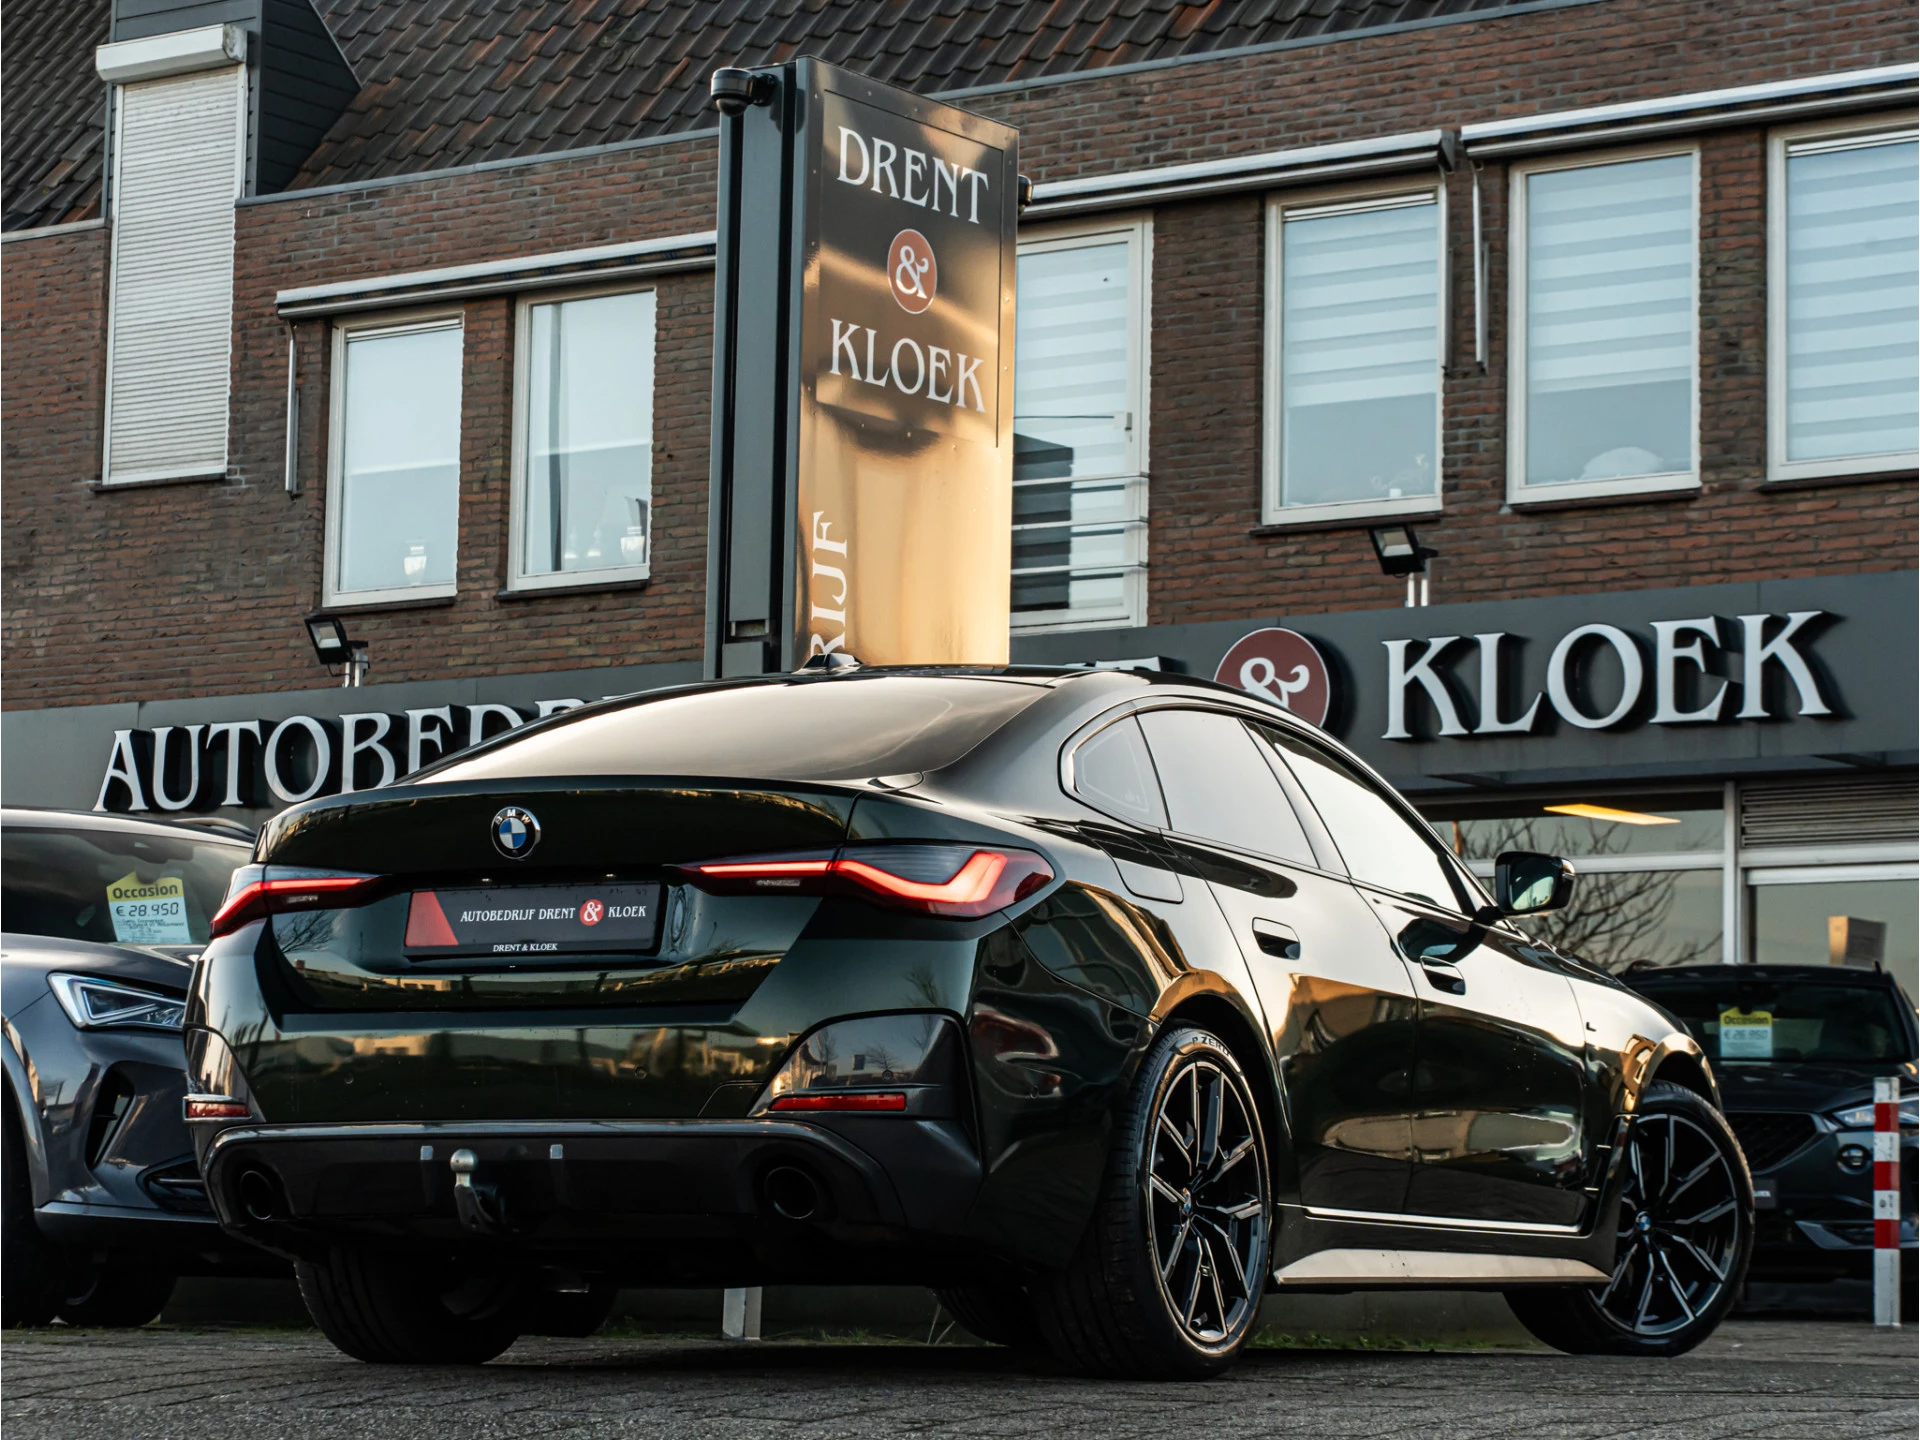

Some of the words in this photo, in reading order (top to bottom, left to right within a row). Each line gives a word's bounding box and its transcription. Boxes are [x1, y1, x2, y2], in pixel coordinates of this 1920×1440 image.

[837, 126, 989, 224] DRENT
[895, 245, 930, 300] &
[829, 318, 986, 414] KLOEK
[1381, 611, 1834, 740] KLOEK
[494, 808, 531, 825] BMW
[112, 884, 178, 899] Occasion
[460, 909, 535, 922] AUTOBEDRIJF
[538, 908, 575, 920] DRENT
[583, 902, 601, 922] &
[608, 906, 646, 918] KLOEK
[493, 944, 521, 952] DRENT
[530, 943, 558, 951] KLOEK
